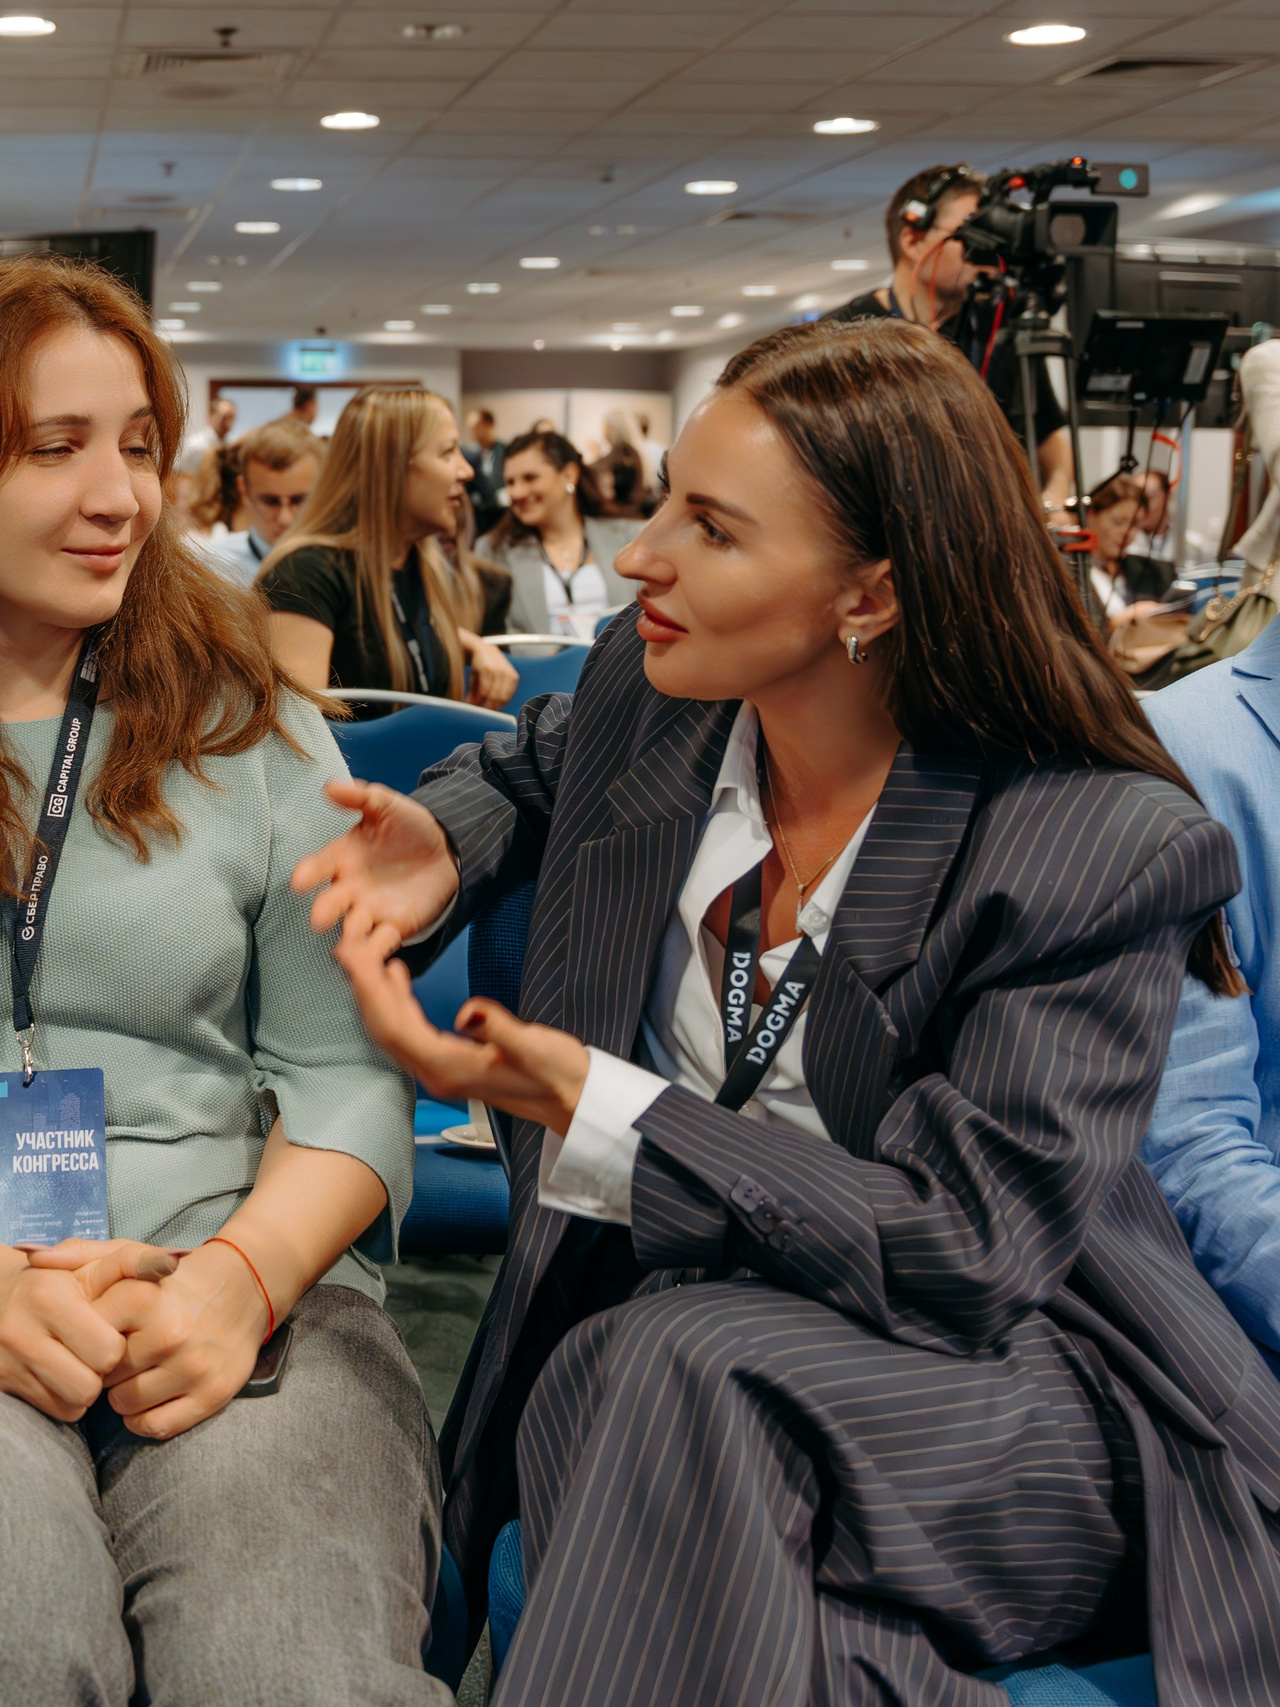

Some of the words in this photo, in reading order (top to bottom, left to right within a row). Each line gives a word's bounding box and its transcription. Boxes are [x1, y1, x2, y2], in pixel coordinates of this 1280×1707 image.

[67, 718, 82, 752] GROUP
[57, 754, 74, 793] CAPITAL
[50, 796, 66, 815] CG
[726, 951, 751, 1043] DOGMA
[745, 980, 806, 1066] DOGMA
[16, 1129, 95, 1151] УЧАСТНИК
[13, 1151, 99, 1174] КОНГРЕССА
